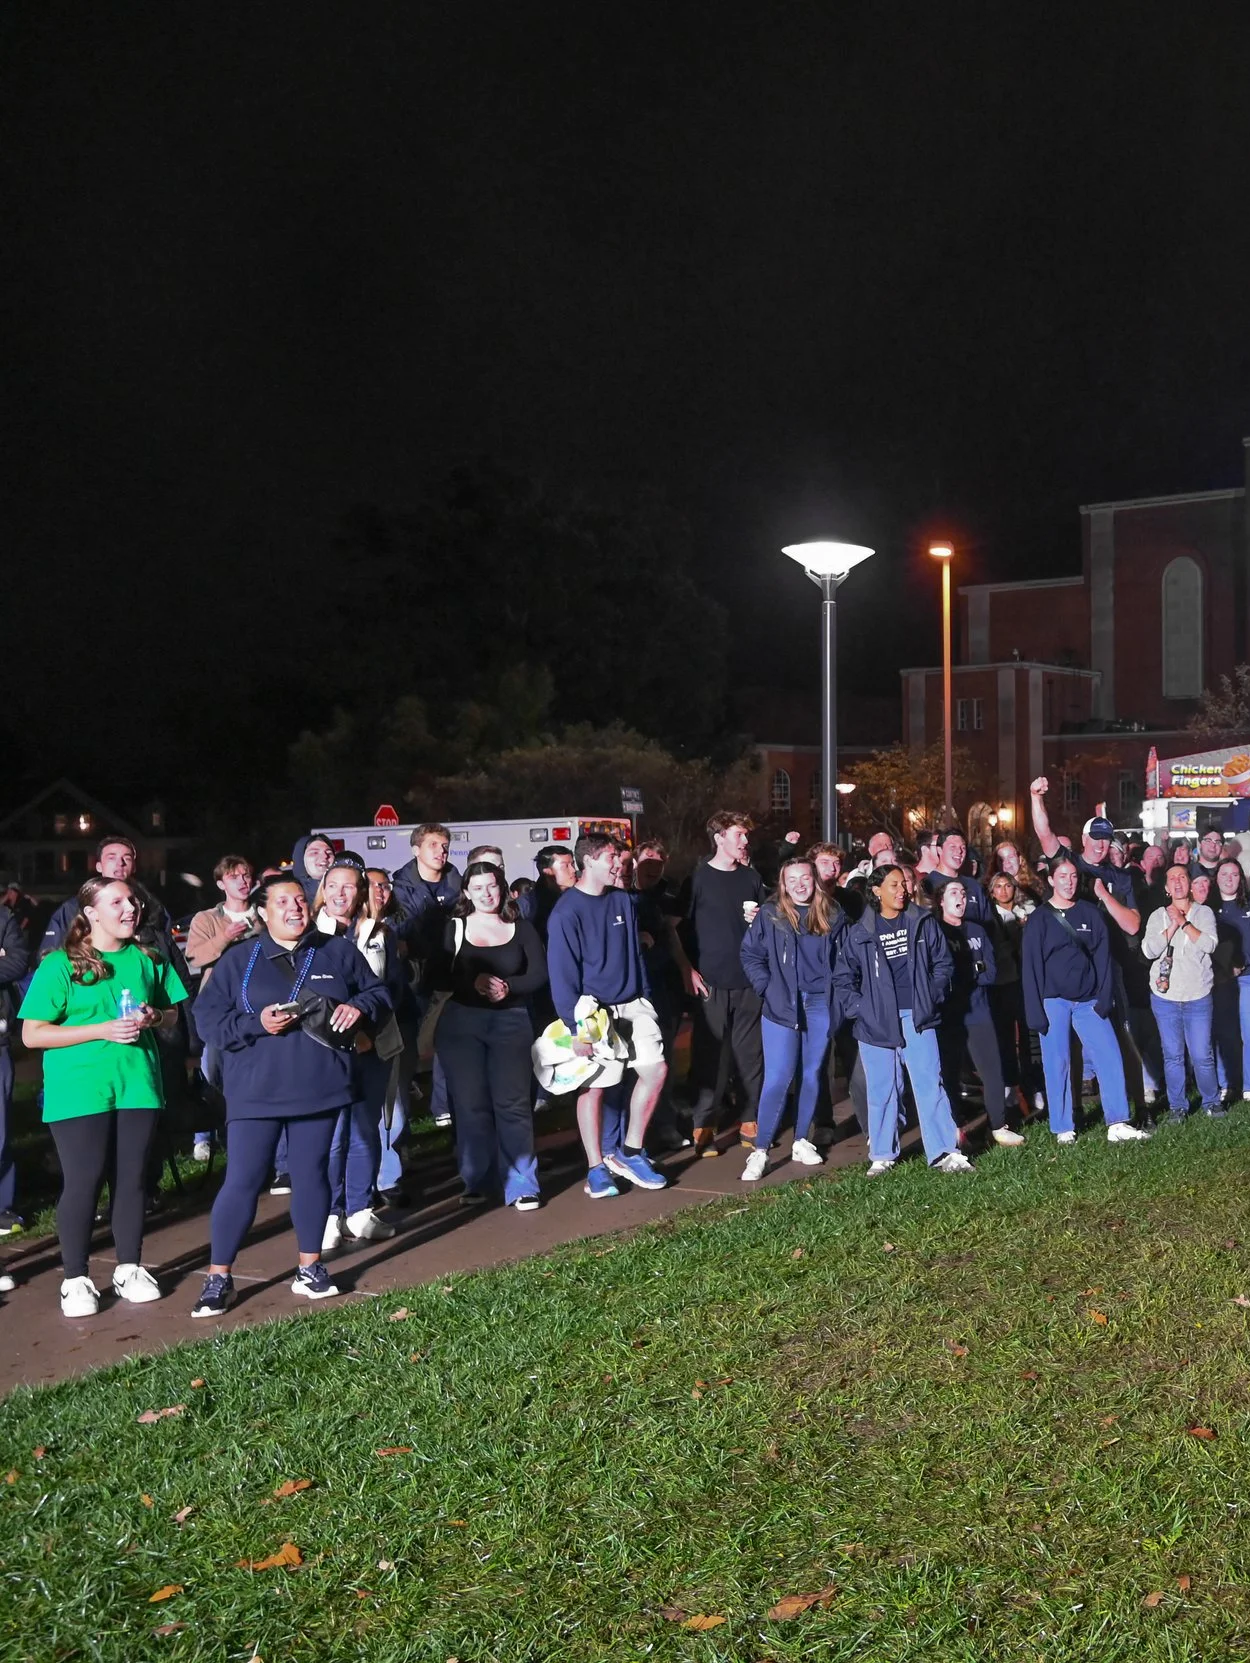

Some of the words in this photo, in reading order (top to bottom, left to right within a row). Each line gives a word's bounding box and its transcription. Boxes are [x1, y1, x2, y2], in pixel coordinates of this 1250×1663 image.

[1171, 763, 1222, 775] Chicken
[1171, 775, 1222, 788] Fingers
[376, 817, 397, 827] STOP
[879, 932, 896, 942] ENN
